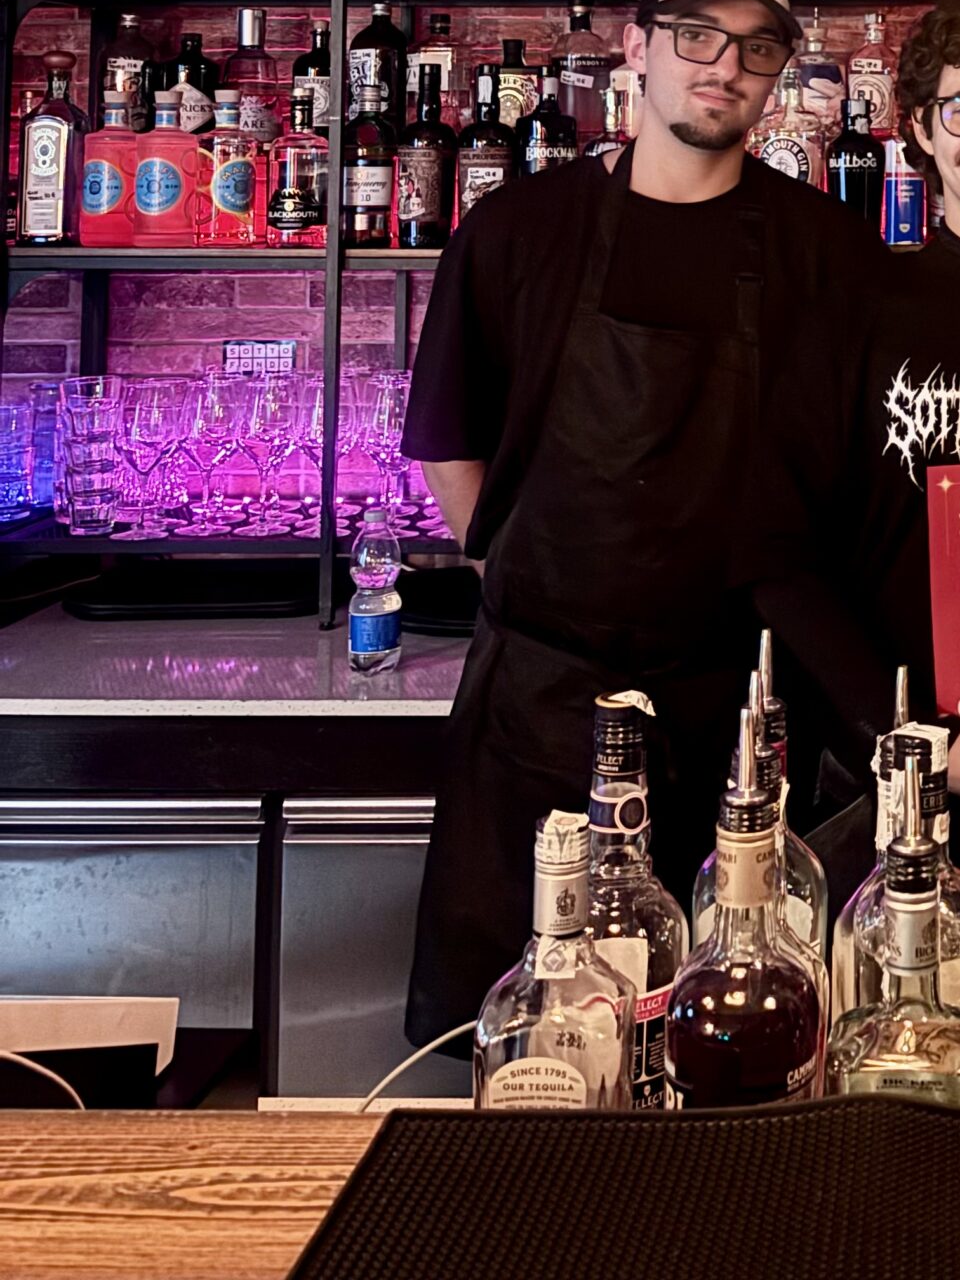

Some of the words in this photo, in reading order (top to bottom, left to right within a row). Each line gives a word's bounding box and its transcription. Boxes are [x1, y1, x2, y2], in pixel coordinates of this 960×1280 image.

[761, 139, 799, 167] YMOUTH
[798, 151, 810, 173] GIN
[828, 152, 878, 168] BULLDOG
[229, 347, 289, 358] SOTTO
[229, 360, 289, 371] FONDO
[509, 1066, 542, 1079] SINCE
[544, 1067, 568, 1079] 1795
[502, 1082, 525, 1092] OUR
[527, 1083, 575, 1093] TEQUILA
